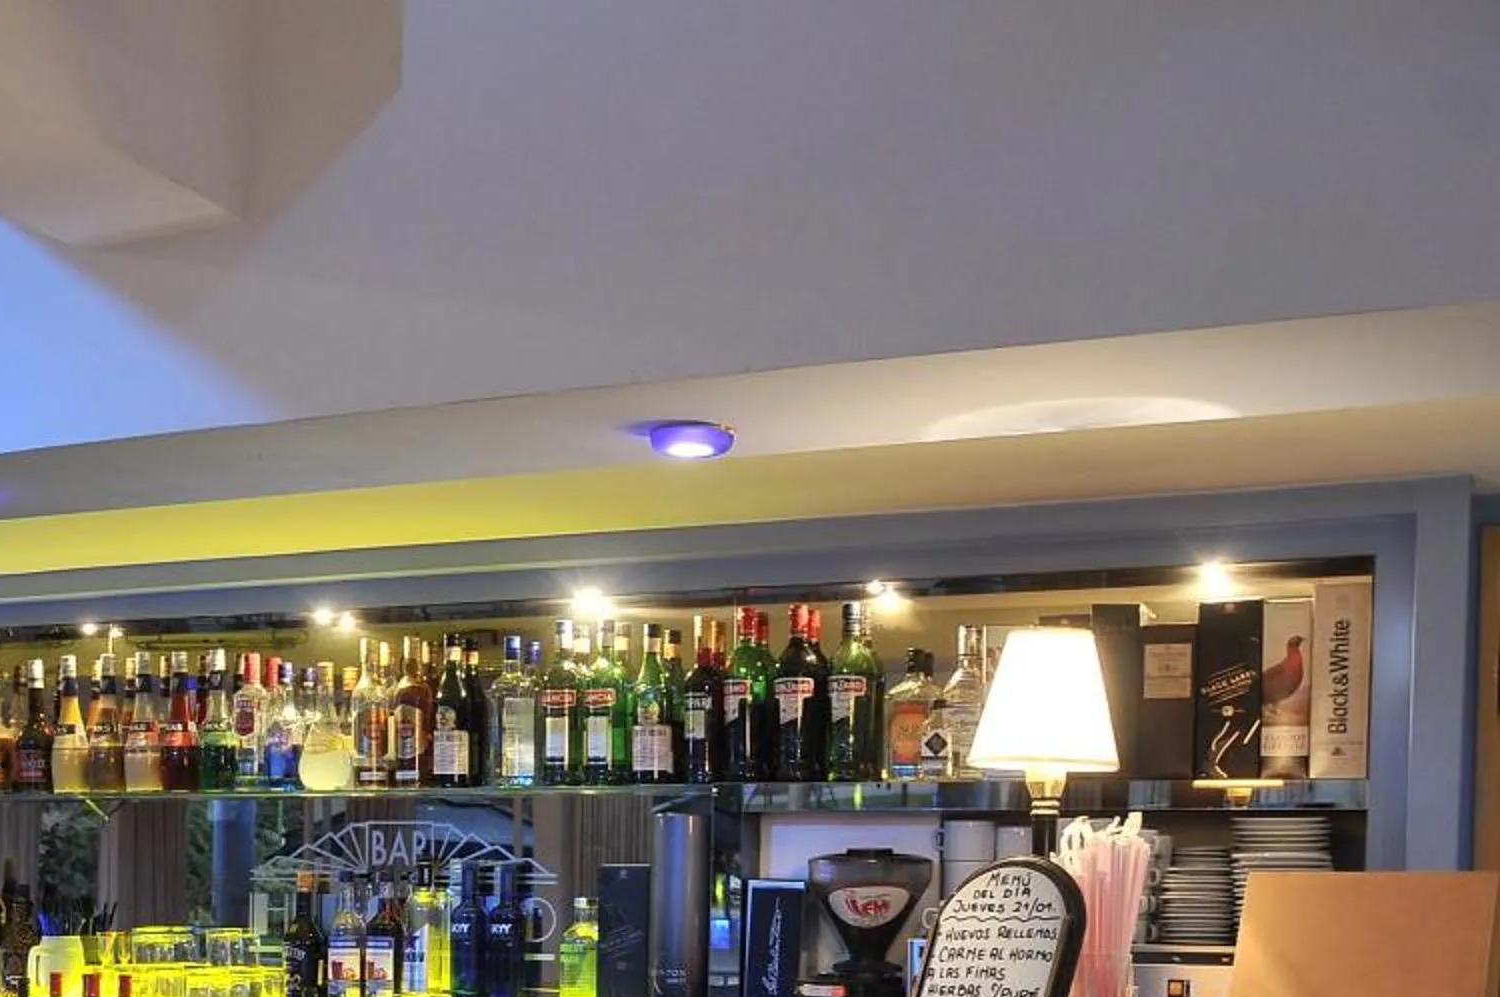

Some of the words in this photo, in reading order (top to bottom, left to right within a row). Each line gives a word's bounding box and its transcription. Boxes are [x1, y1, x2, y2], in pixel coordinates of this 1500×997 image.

[1328, 618, 1352, 735] Black&White
[973, 889, 995, 899] DEL
[990, 948, 1005, 961] AL
[939, 968, 961, 979] LAS
